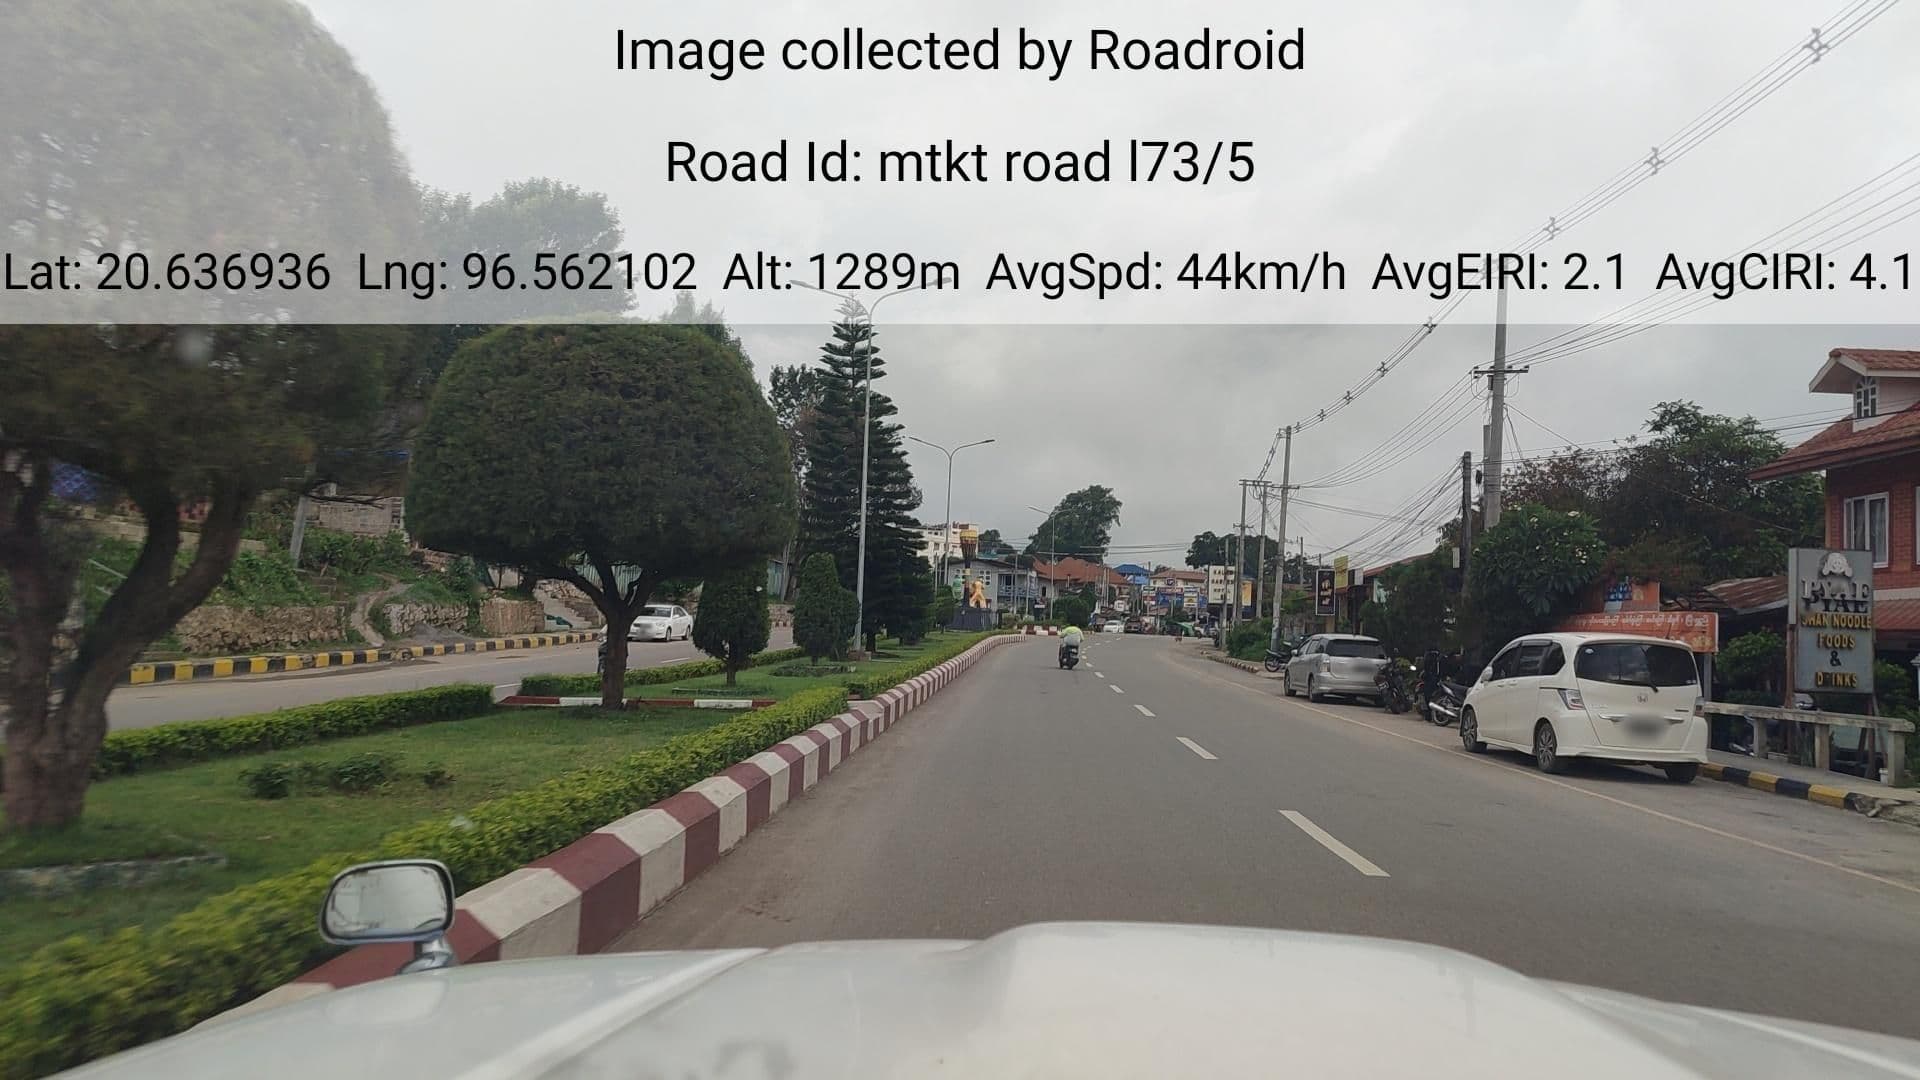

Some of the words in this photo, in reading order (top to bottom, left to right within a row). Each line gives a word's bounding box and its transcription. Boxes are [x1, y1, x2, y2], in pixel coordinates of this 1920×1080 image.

[1832, 614, 1872, 629] NOODLE
[1818, 633, 1856, 649] FOODS
[1830, 651, 1841, 666] &
[1816, 672, 1857, 688] DINKS
